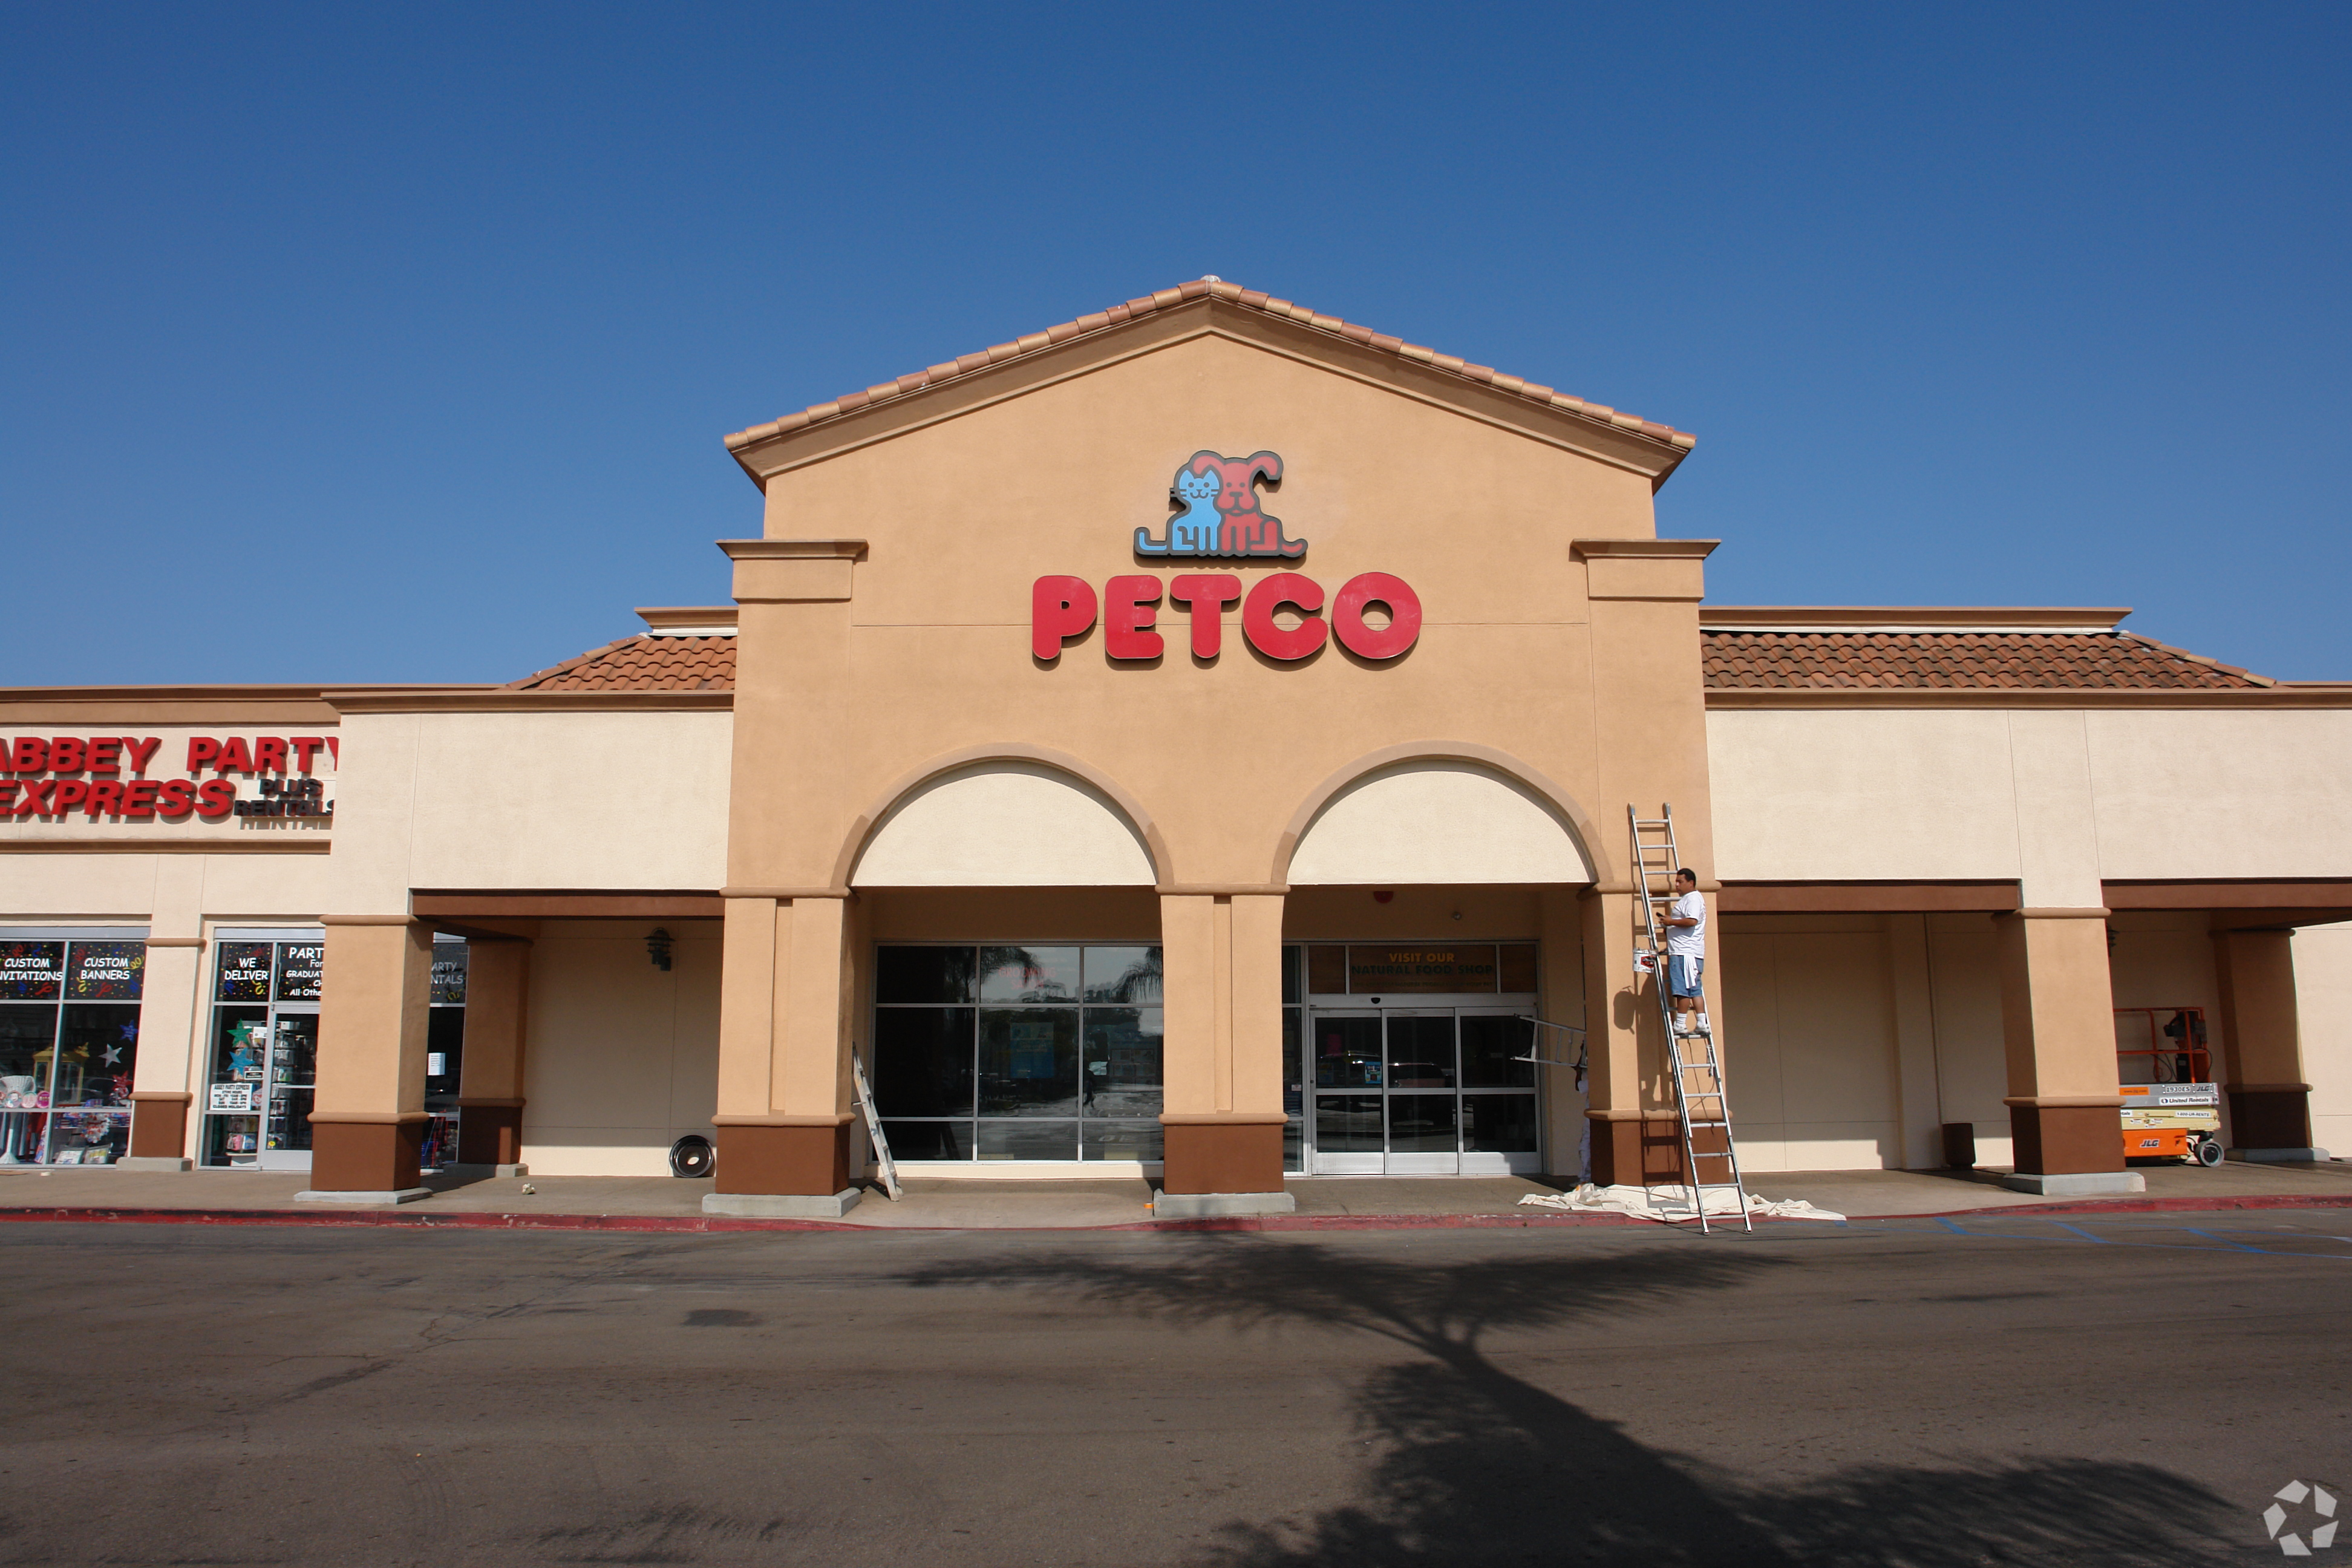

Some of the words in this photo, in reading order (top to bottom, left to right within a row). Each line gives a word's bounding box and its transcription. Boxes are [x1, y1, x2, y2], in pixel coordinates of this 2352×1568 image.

[1031, 572, 1422, 660] PETCO
[0, 737, 162, 772] BBEY
[259, 779, 324, 796] PLUS
[289, 947, 325, 959] PART
[1388, 953, 1422, 962] VISIT
[1426, 953, 1455, 962] OUR
[4, 958, 50, 968] CUSTOM
[84, 958, 129, 967] CUSTOM
[238, 958, 257, 968] WE
[310, 959, 324, 968] For
[80, 970, 130, 980] BANNERS
[998, 967, 1056, 978] GROOMING
[1351, 965, 1411, 975] NATURAL
[1416, 965, 1452, 975] FOOD
[1458, 965, 1493, 975] SHOP
[224, 970, 269, 981] DELIVER
[2140, 1139, 2160, 1148] JLG
